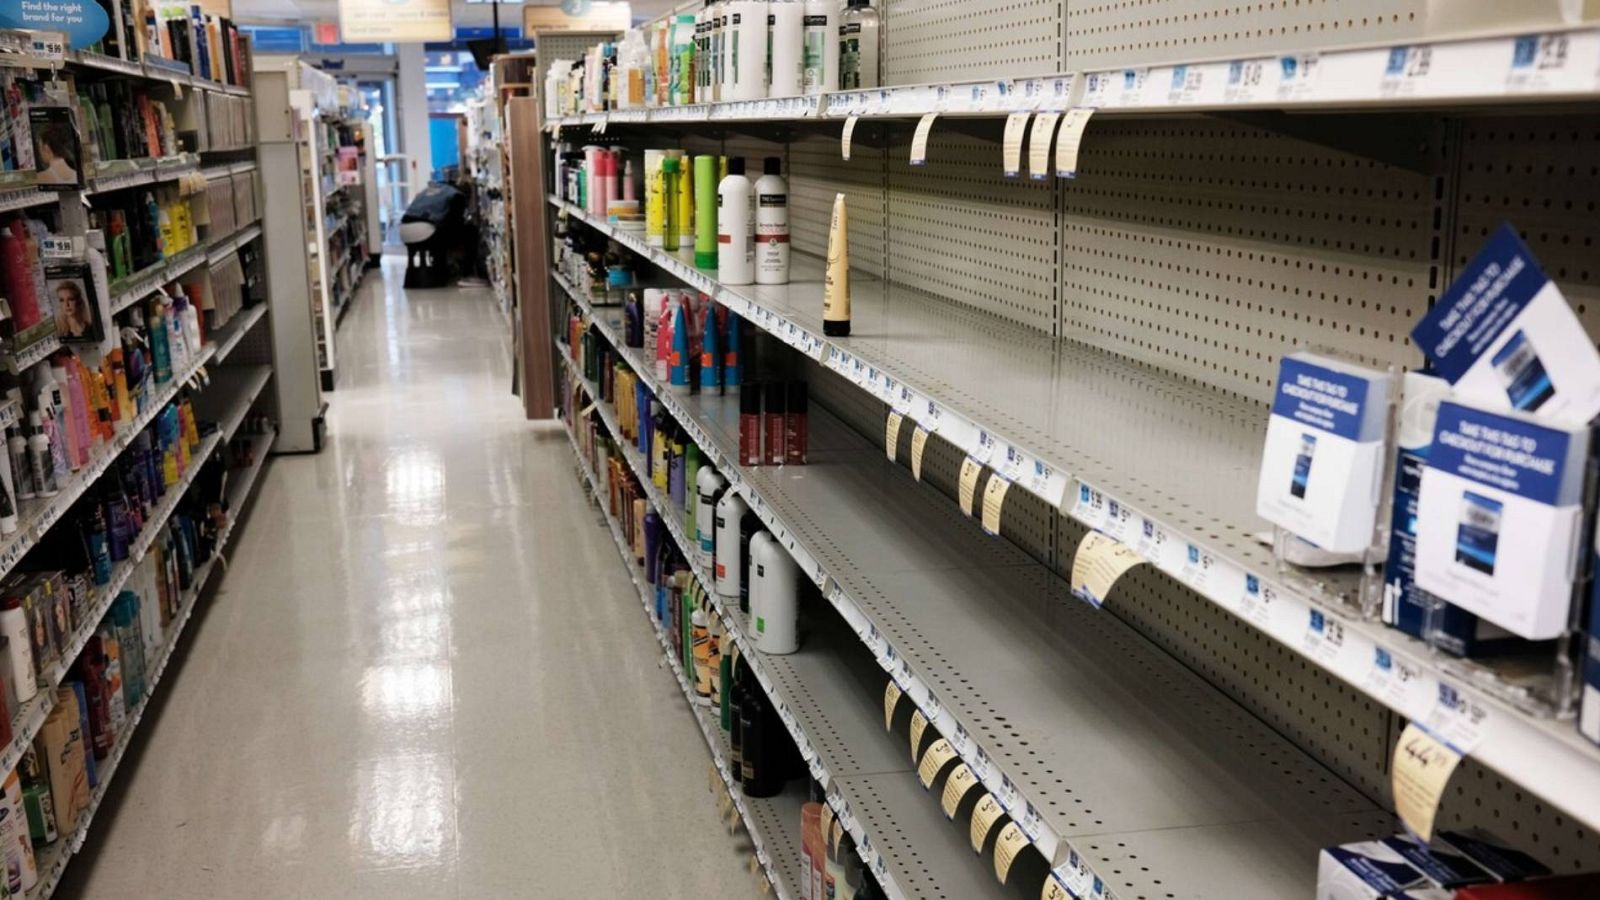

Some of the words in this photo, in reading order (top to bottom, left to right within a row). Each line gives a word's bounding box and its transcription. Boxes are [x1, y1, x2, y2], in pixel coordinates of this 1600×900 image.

[21, 1, 42, 11] Find
[43, 2, 58, 11] the
[60, 3, 82, 15] right
[22, 11, 50, 21] brand
[51, 13, 65, 22] for
[67, 16, 82, 24] you
